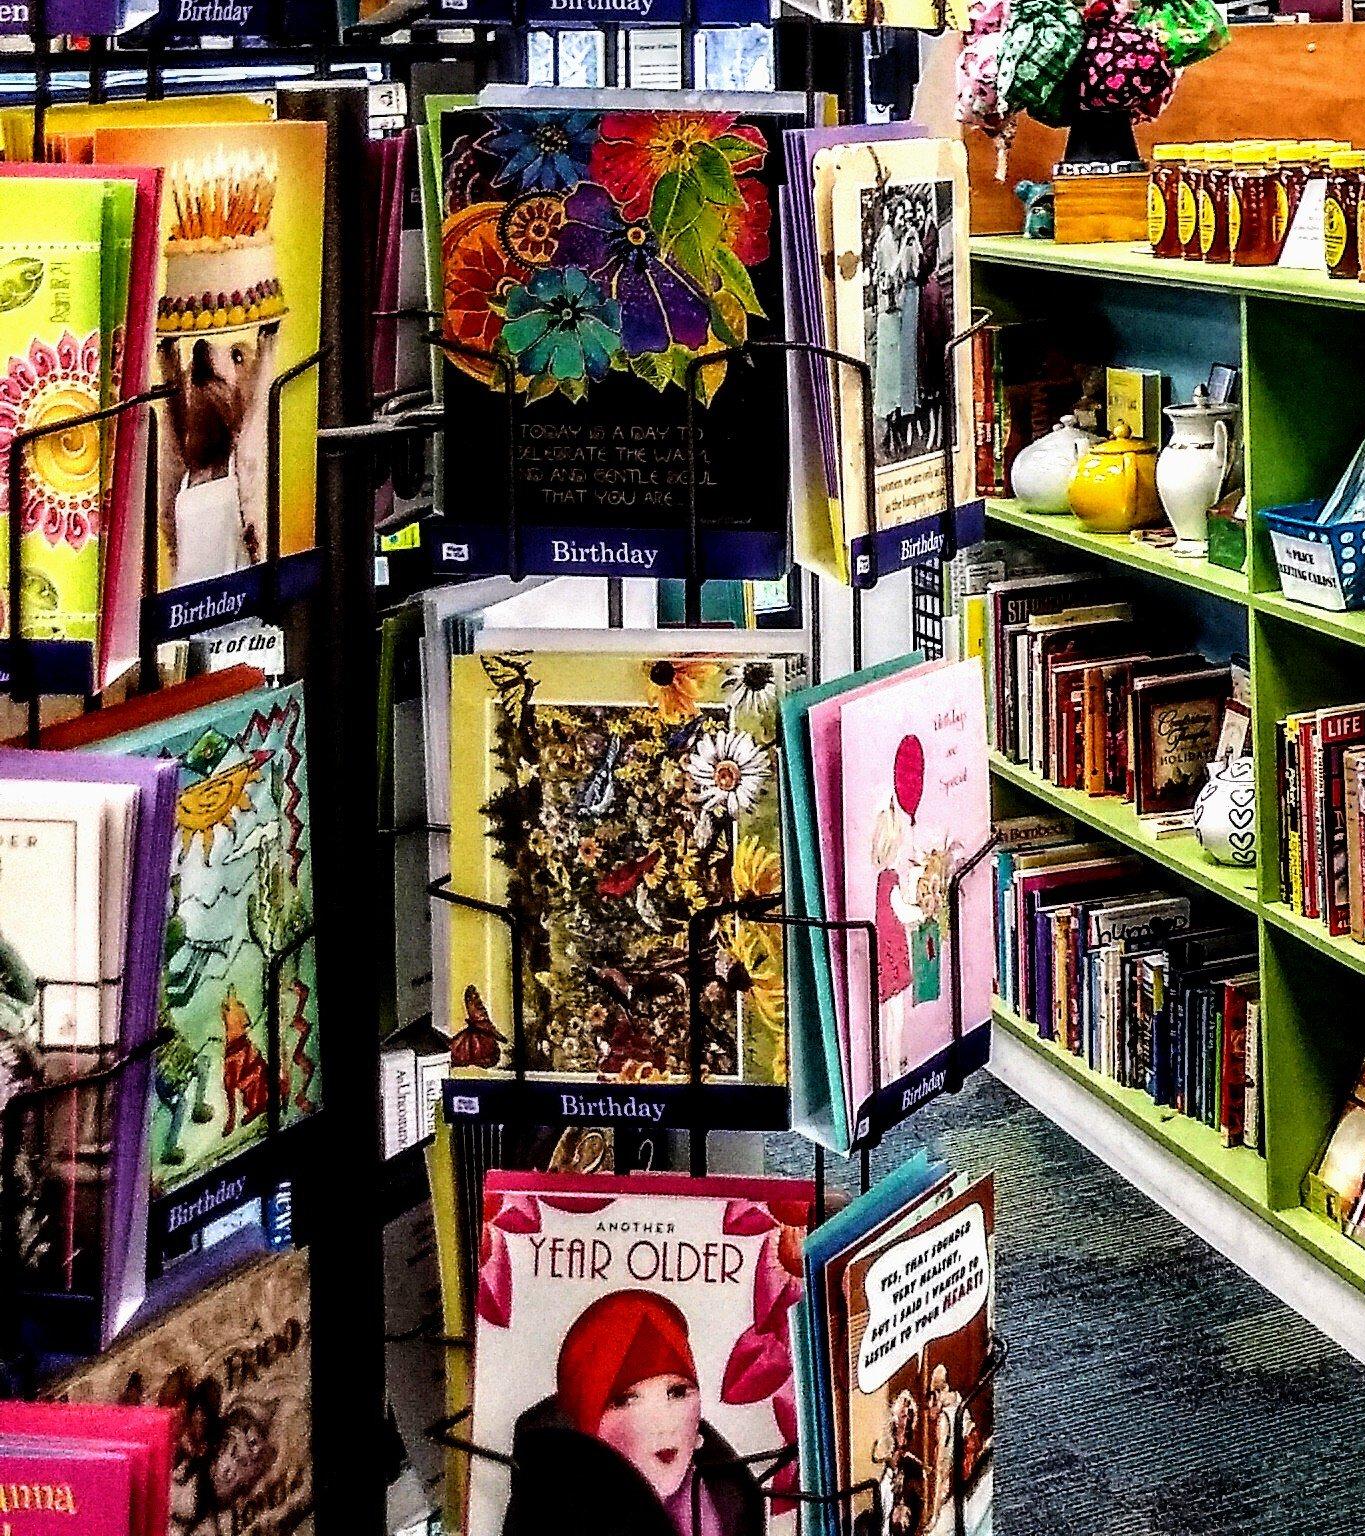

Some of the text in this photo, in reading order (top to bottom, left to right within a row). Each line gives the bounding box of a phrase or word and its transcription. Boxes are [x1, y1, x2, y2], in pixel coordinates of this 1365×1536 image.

[552, 538, 659, 568] Birthday
[900, 530, 945, 561] Birthday
[169, 589, 247, 630] Birthday
[226, 632, 277, 654] of the
[1326, 716, 1362, 739] LIFE
[901, 1064, 948, 1112] Birthday
[560, 1093, 667, 1121] Birthday
[168, 1171, 248, 1234] Birthday
[594, 1220, 677, 1235] ANOTHER
[527, 1236, 745, 1286] YEAR OLDER
